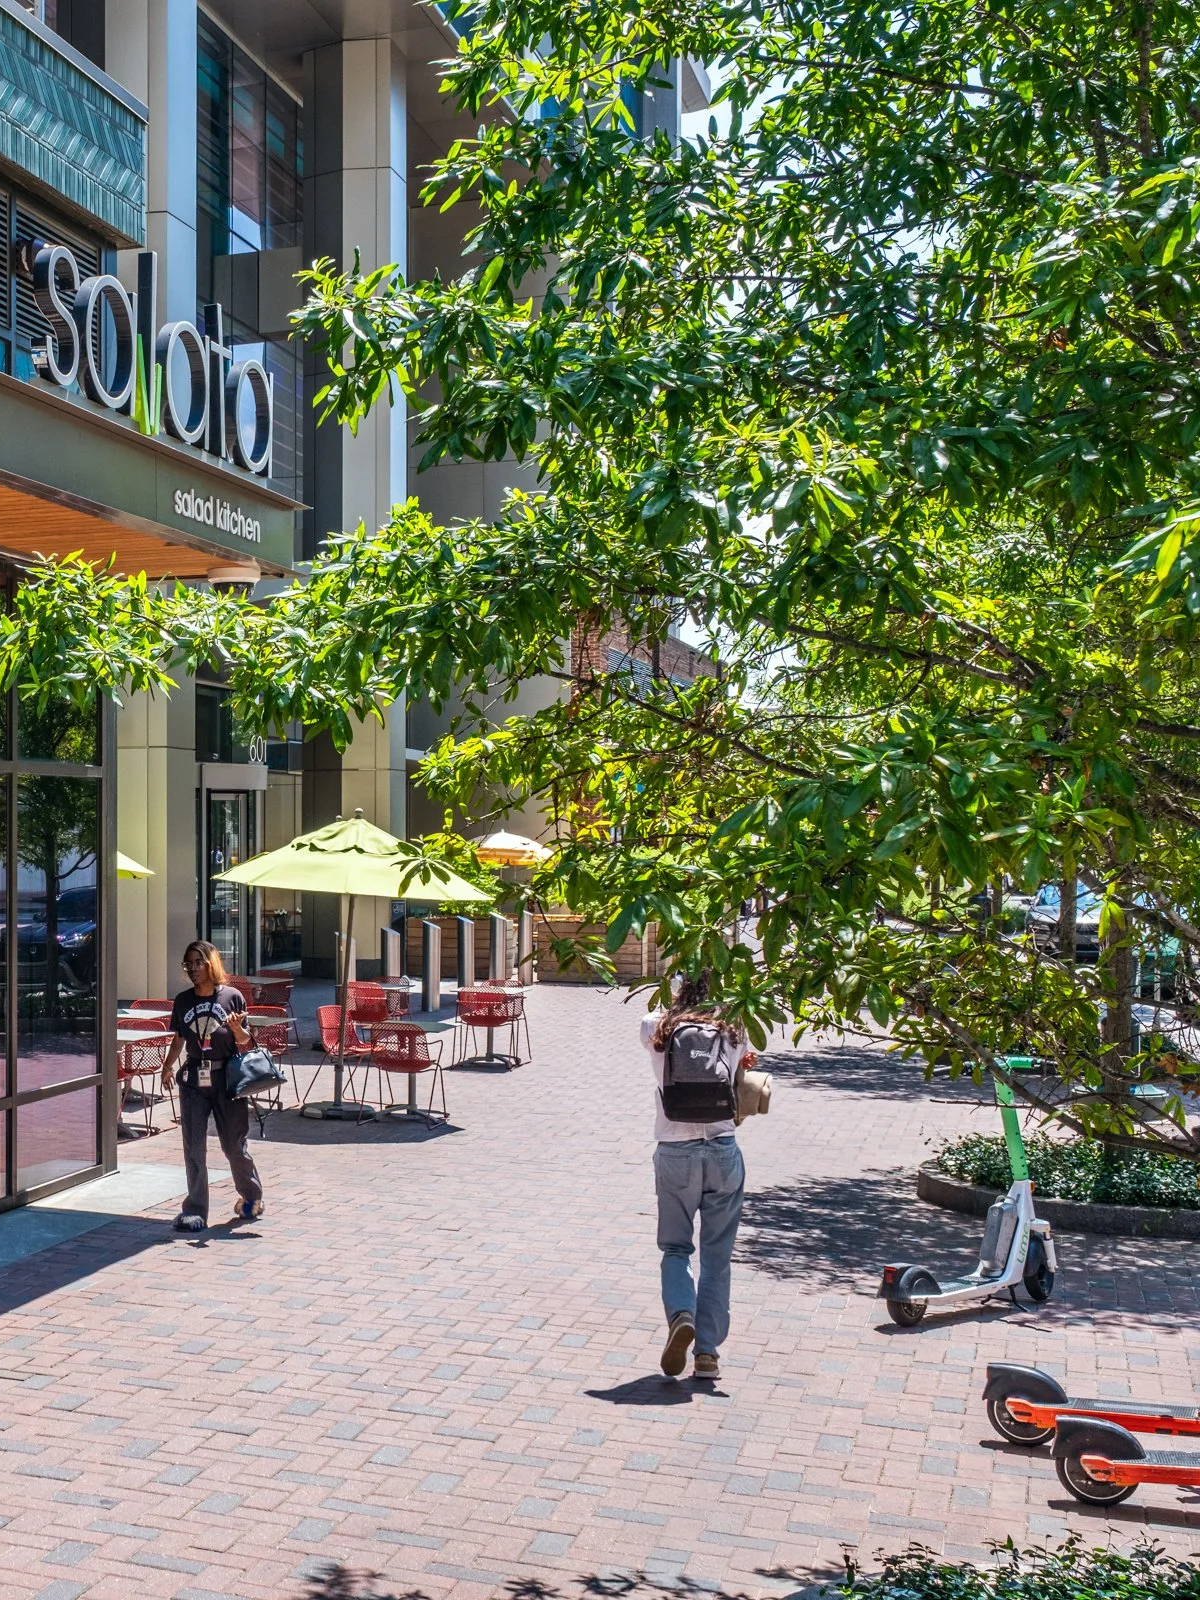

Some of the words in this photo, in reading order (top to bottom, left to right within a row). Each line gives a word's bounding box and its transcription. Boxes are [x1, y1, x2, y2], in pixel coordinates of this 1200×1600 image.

[174, 489, 214, 526] salad
[216, 499, 260, 543] kitchen
[250, 734, 267, 763] 601
[1016, 1222, 1029, 1264] Lime
